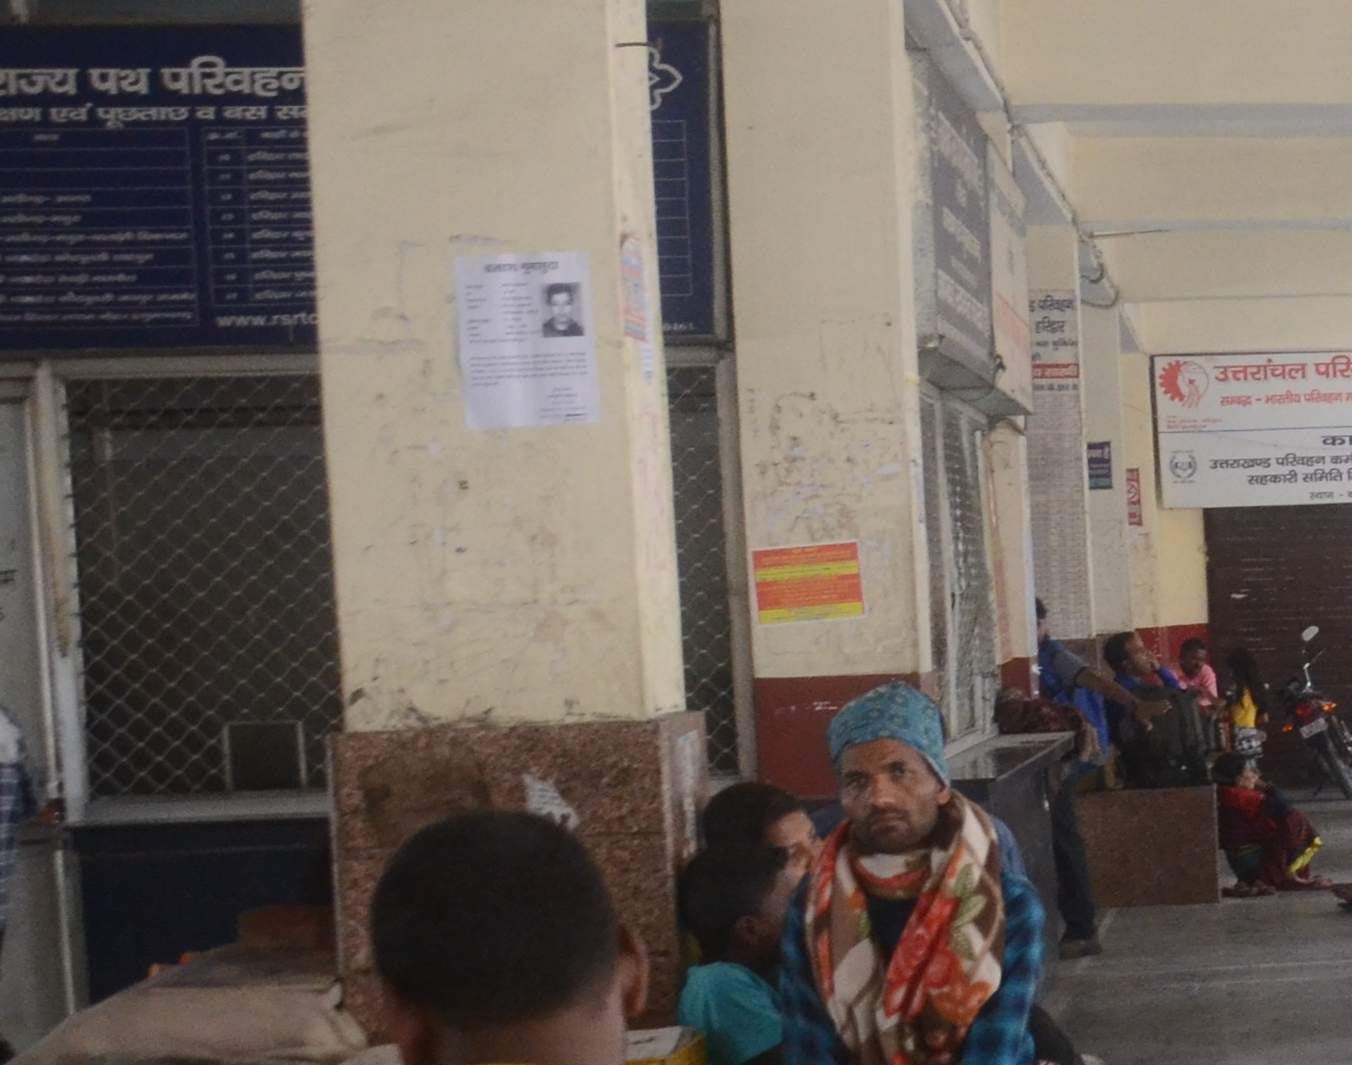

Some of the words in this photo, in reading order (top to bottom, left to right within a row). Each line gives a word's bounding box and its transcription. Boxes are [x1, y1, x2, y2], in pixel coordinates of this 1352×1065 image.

[87, 66, 151, 95] पथ
[49, 101, 93, 122] एवं
[97, 105, 191, 129] पूछताछ
[1214, 358, 1308, 382] उत्तरांचल
[1209, 457, 1271, 470] उत्तराखण्ड
[1276, 453, 1325, 468] परिवहन
[1248, 469, 1298, 486] सहकारी
[1302, 467, 1343, 484] समिति
